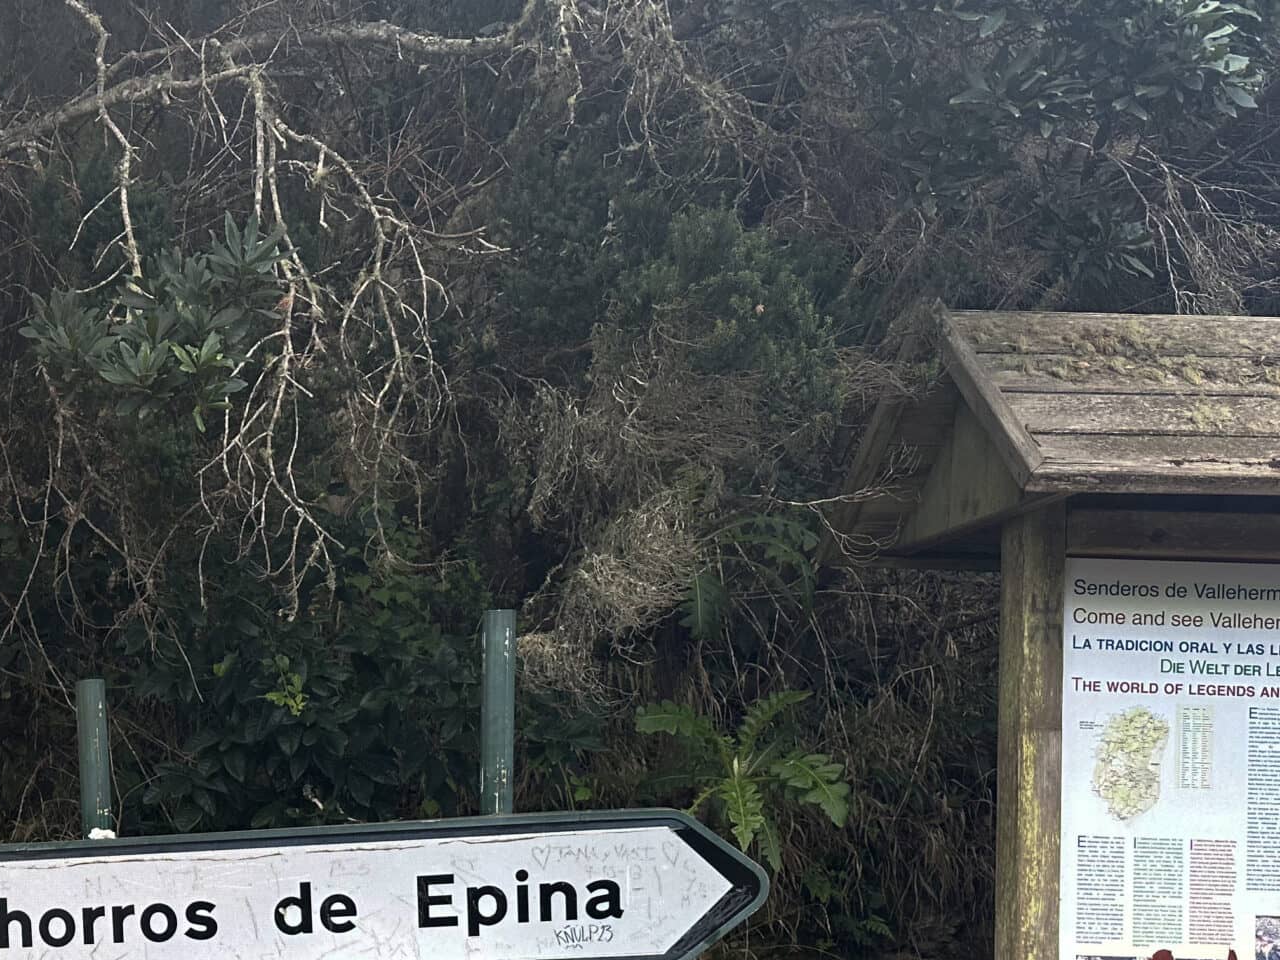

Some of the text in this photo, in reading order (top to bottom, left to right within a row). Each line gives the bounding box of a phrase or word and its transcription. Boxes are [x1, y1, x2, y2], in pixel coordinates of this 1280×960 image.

[1074, 579, 1159, 598] Senderos
[1165, 583, 1188, 598] de
[1073, 607, 1126, 625] Come
[1132, 611, 1165, 626] and
[1171, 614, 1204, 628] see
[1223, 642, 1232, 655] Y
[273, 881, 358, 935] de
[416, 869, 625, 937] Epina
